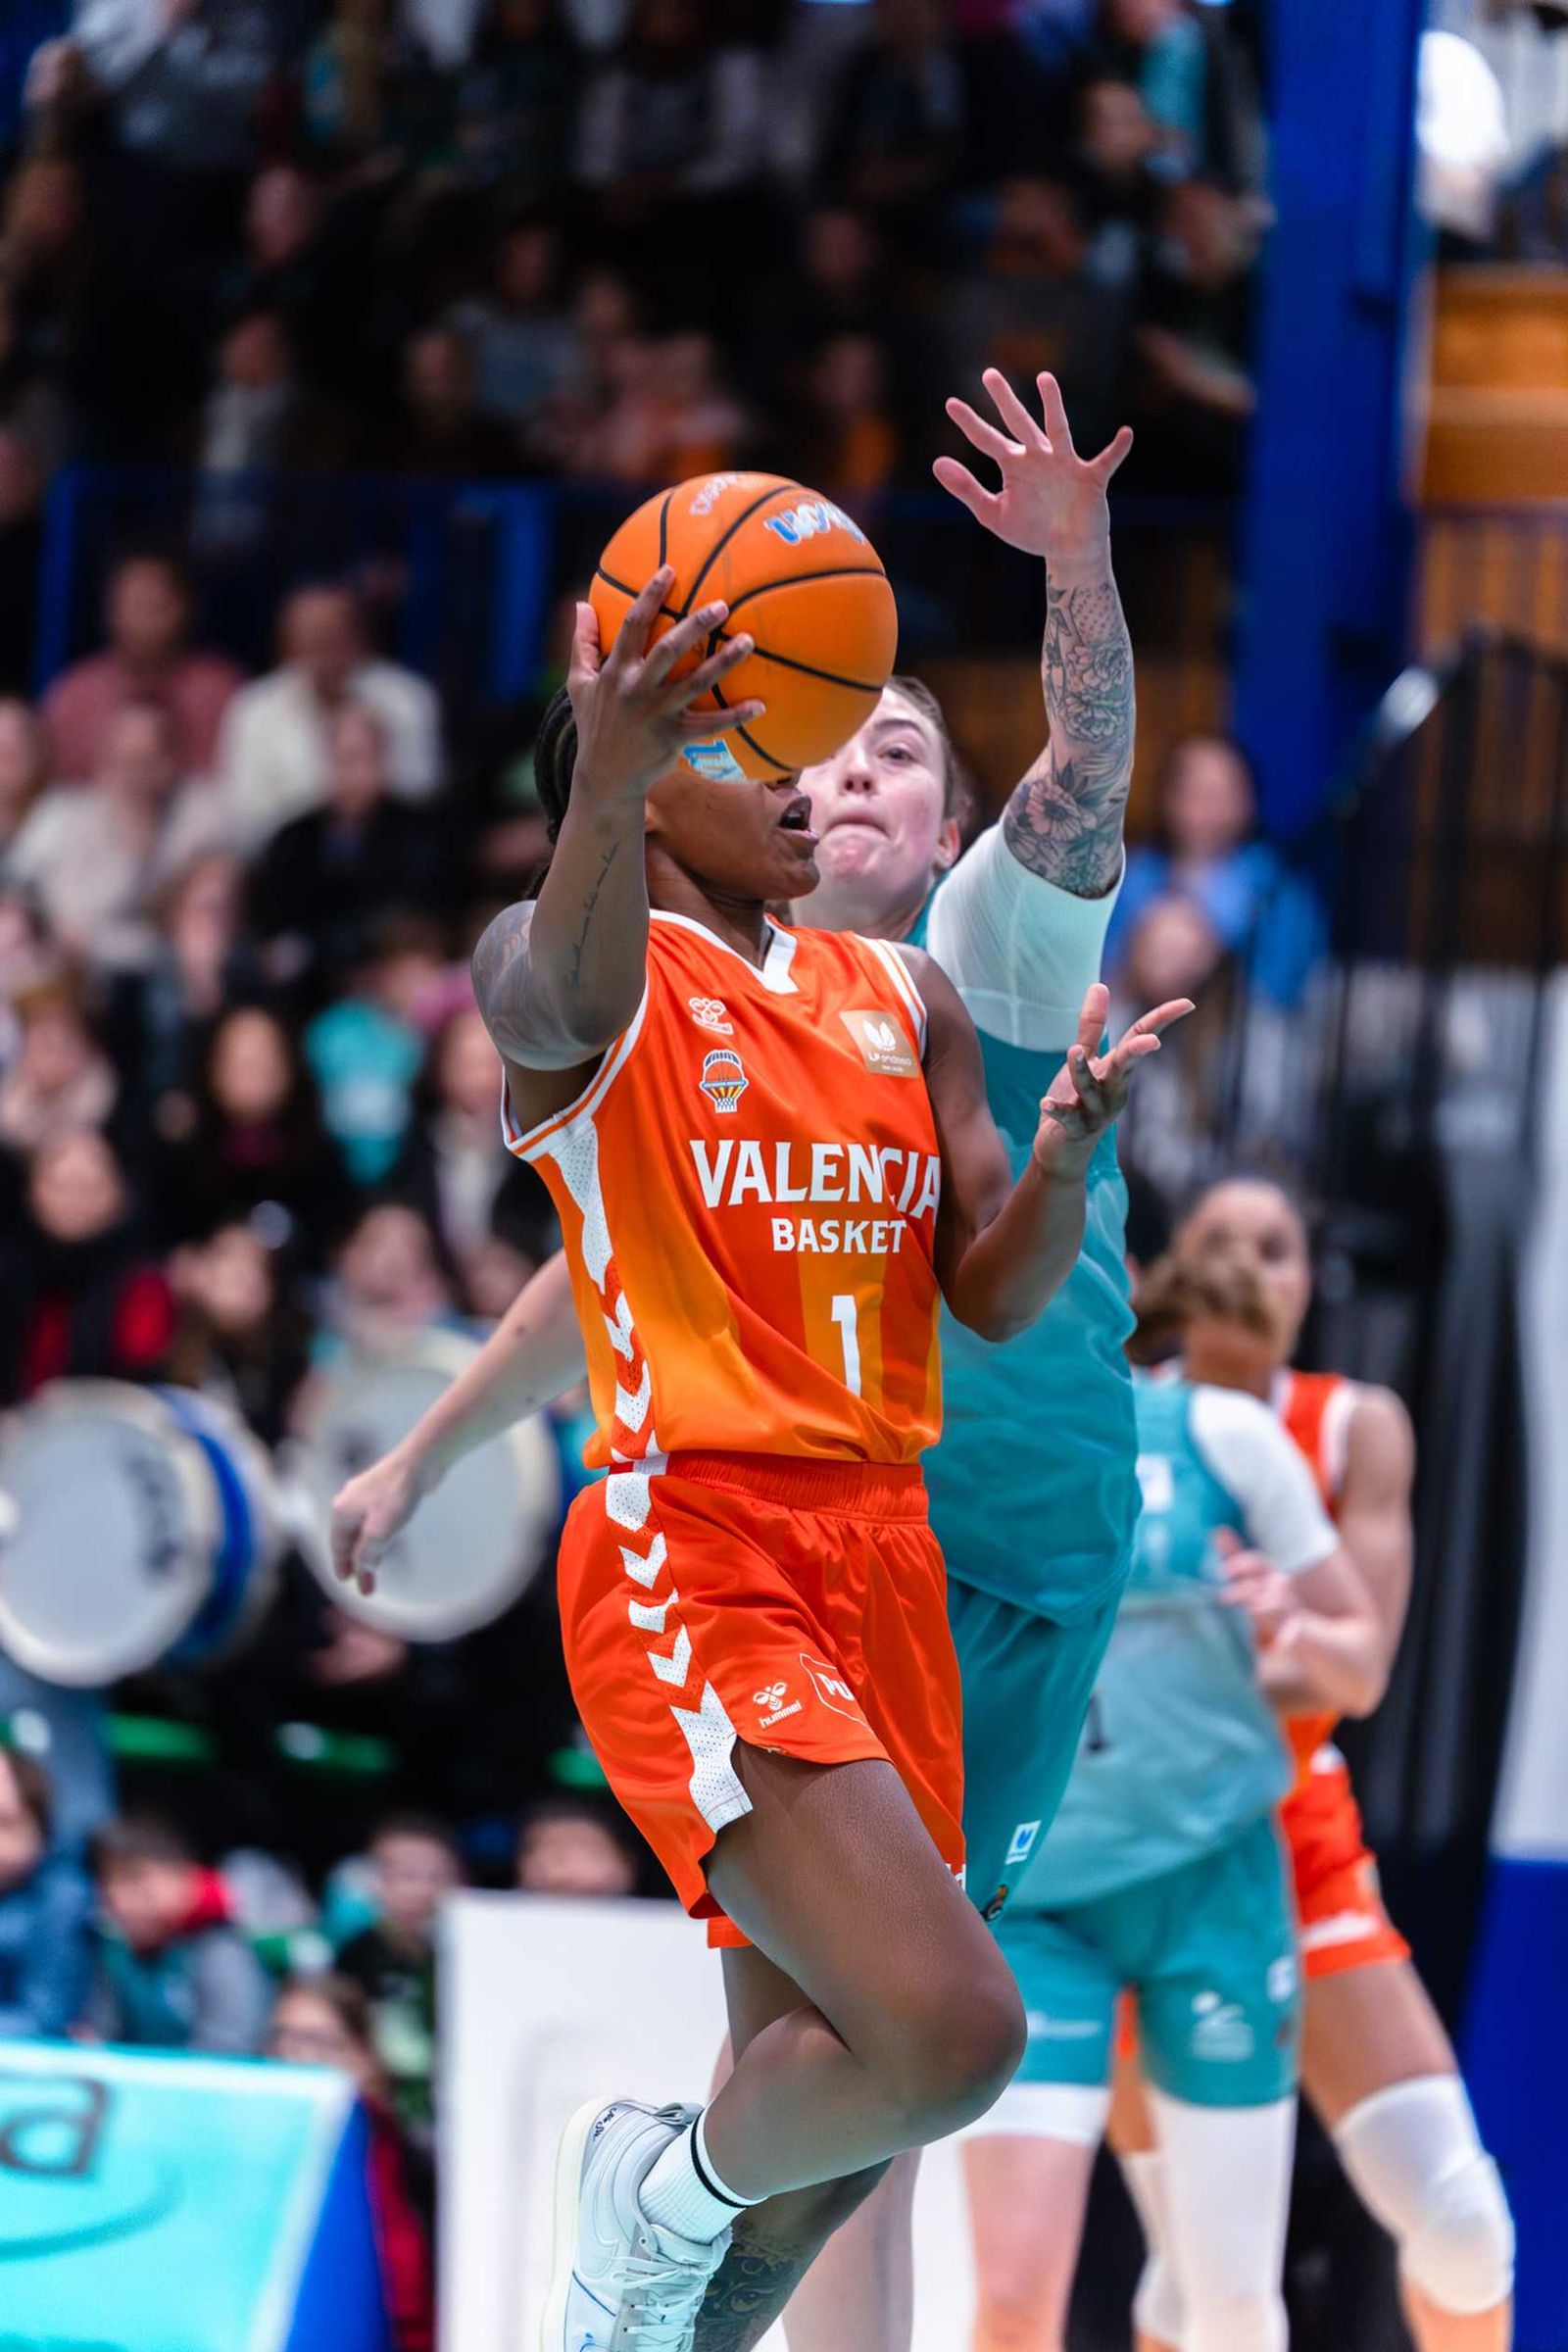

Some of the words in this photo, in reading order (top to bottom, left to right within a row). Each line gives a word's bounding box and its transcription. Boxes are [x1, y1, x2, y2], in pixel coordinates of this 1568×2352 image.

[689, 1139, 941, 1219] VALENCIA
[770, 1217, 907, 1254] BASKET
[831, 1295, 861, 1398] 1
[759, 1699, 804, 1731] hummel
